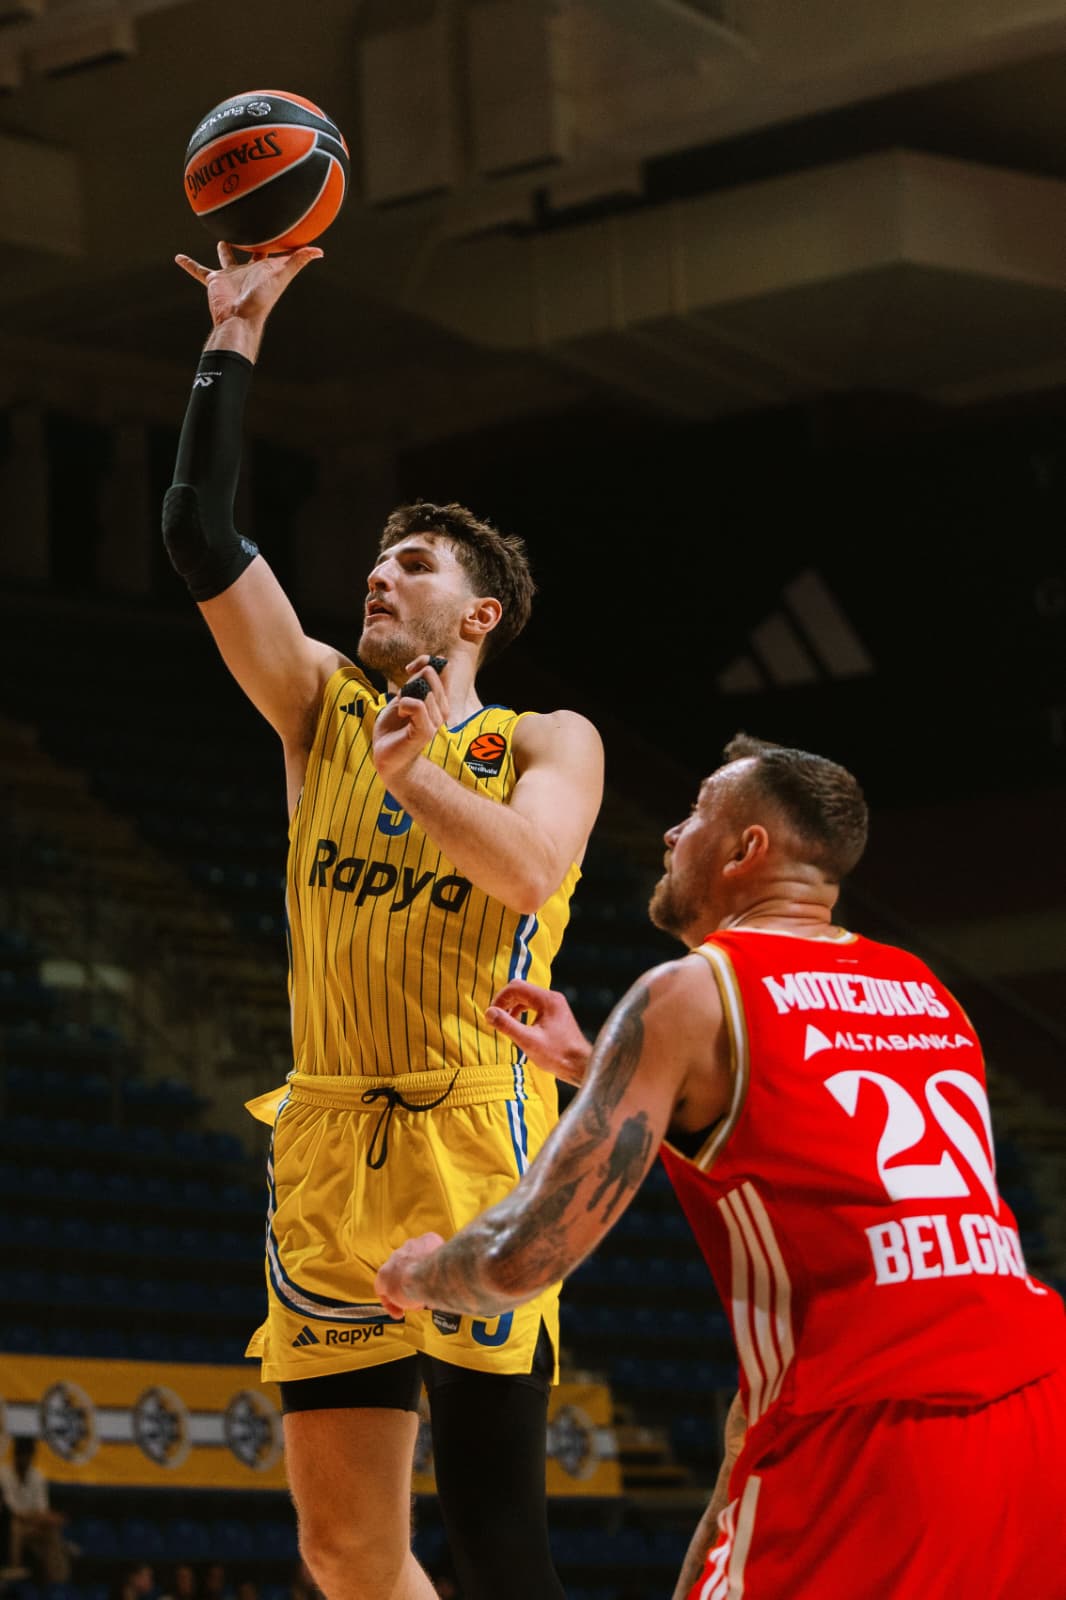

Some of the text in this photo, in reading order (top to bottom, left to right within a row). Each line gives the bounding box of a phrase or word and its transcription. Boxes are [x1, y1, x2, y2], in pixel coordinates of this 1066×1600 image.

[186, 130, 282, 200] SPALDING
[761, 970, 950, 1019] MOTIEJUNAS
[834, 1031, 974, 1052] ALTABANKA
[823, 1069, 999, 1217] 20
[864, 1212, 1047, 1296] BELGR
